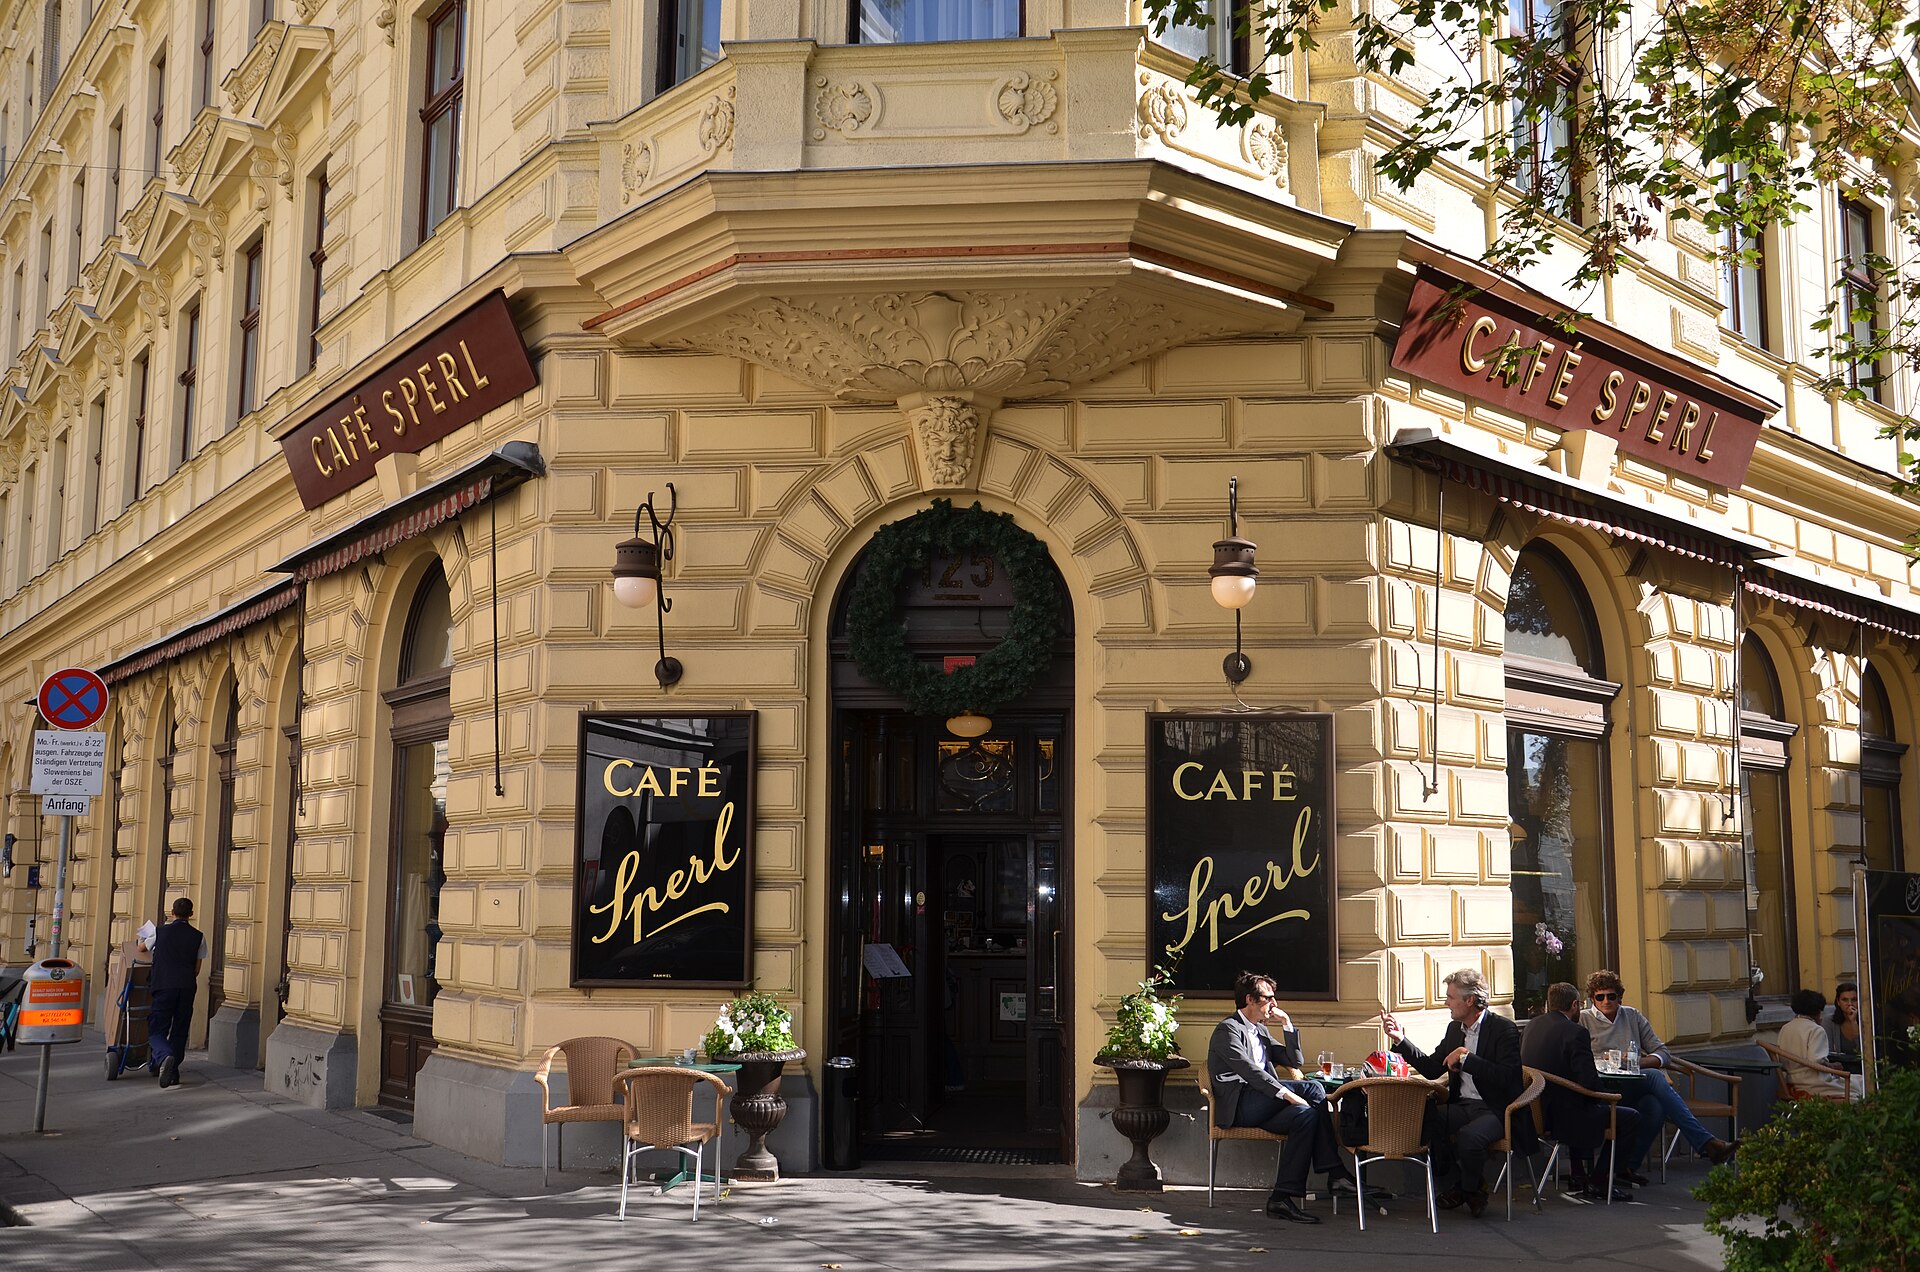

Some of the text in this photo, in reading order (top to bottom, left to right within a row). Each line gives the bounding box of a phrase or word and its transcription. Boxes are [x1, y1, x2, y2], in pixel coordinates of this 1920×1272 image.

[1462, 315, 1719, 461] CAFÉ SPERL
[311, 339, 490, 478] CAFÉ SPERL
[35, 758, 103, 768] Ständigen Vertretung
[43, 768, 81, 776] Sloweniens
[61, 749, 92, 758] Fahrzeuge
[64, 778, 83, 786] OSZE
[603, 759, 722, 797] CAFÉ
[1172, 761, 1298, 801] CAFÉ
[589, 802, 741, 944] Sperl
[1162, 805, 1320, 953] Sperl
